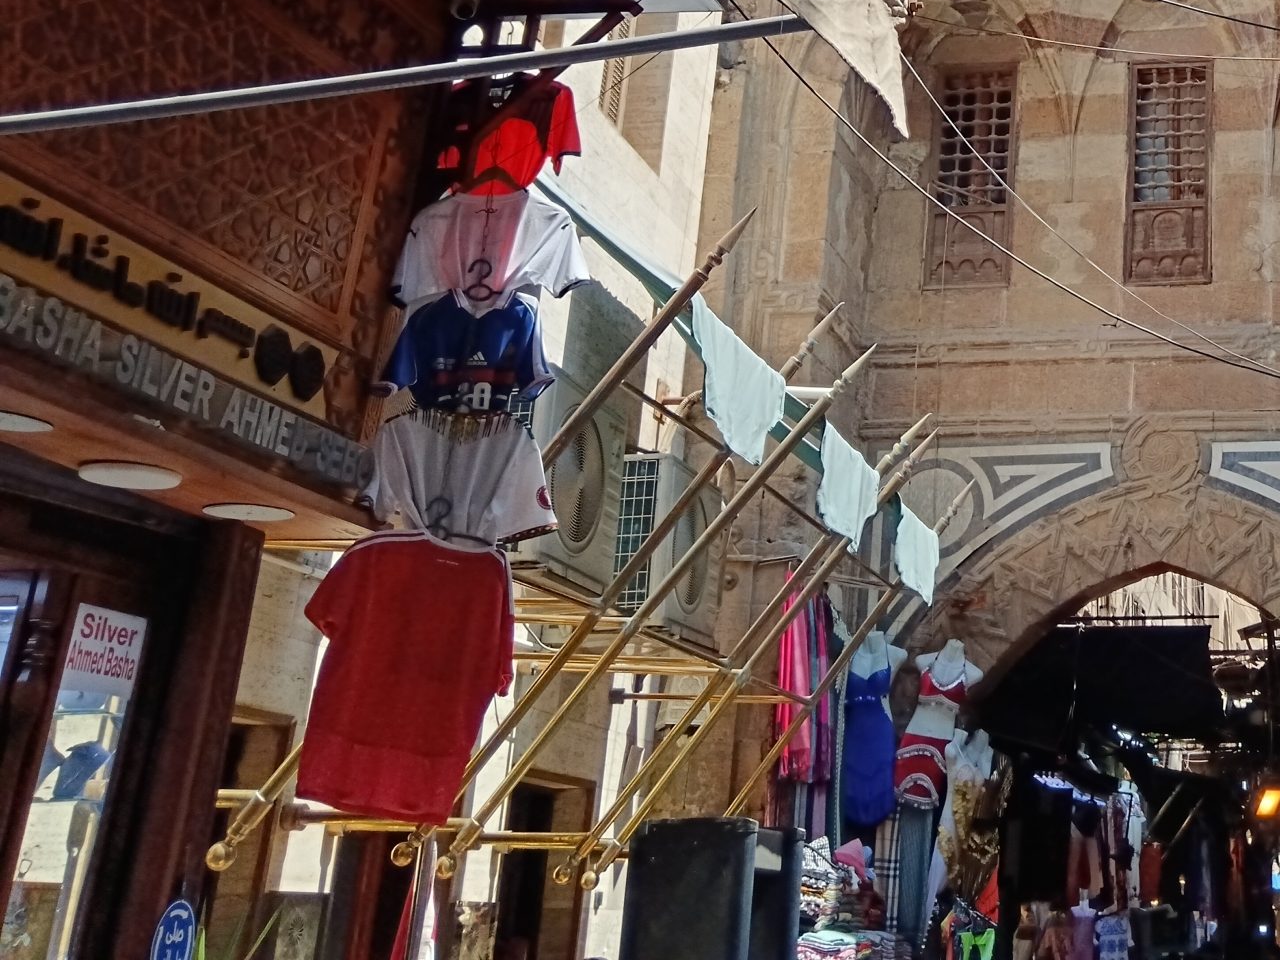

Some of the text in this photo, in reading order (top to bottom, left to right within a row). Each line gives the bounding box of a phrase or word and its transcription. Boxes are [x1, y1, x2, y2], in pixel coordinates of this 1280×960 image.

[115, 334, 217, 421] SILVER
[220, 393, 308, 463] AHMED
[80, 613, 138, 647] Silver
[66, 640, 136, 680] Ahmed Basha
